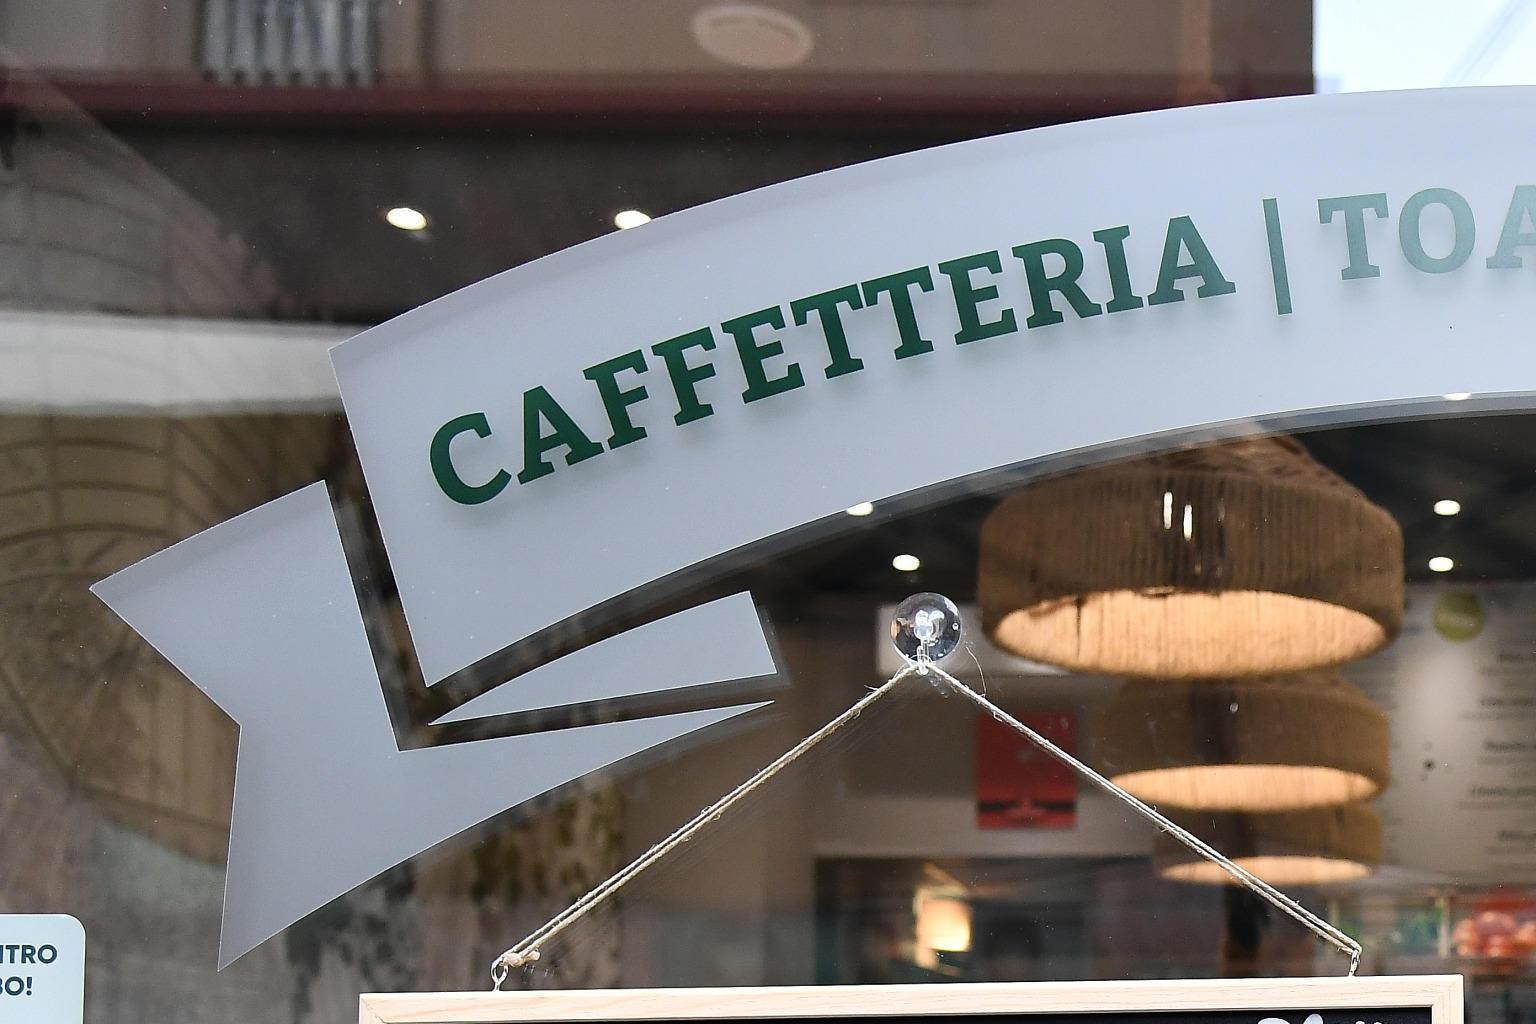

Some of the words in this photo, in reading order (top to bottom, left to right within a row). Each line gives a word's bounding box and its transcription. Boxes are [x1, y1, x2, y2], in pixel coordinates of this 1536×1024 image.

[430, 215, 1236, 506] CAFFETTERIA
[0, 944, 58, 964] TRO
[0, 976, 33, 996] O!
